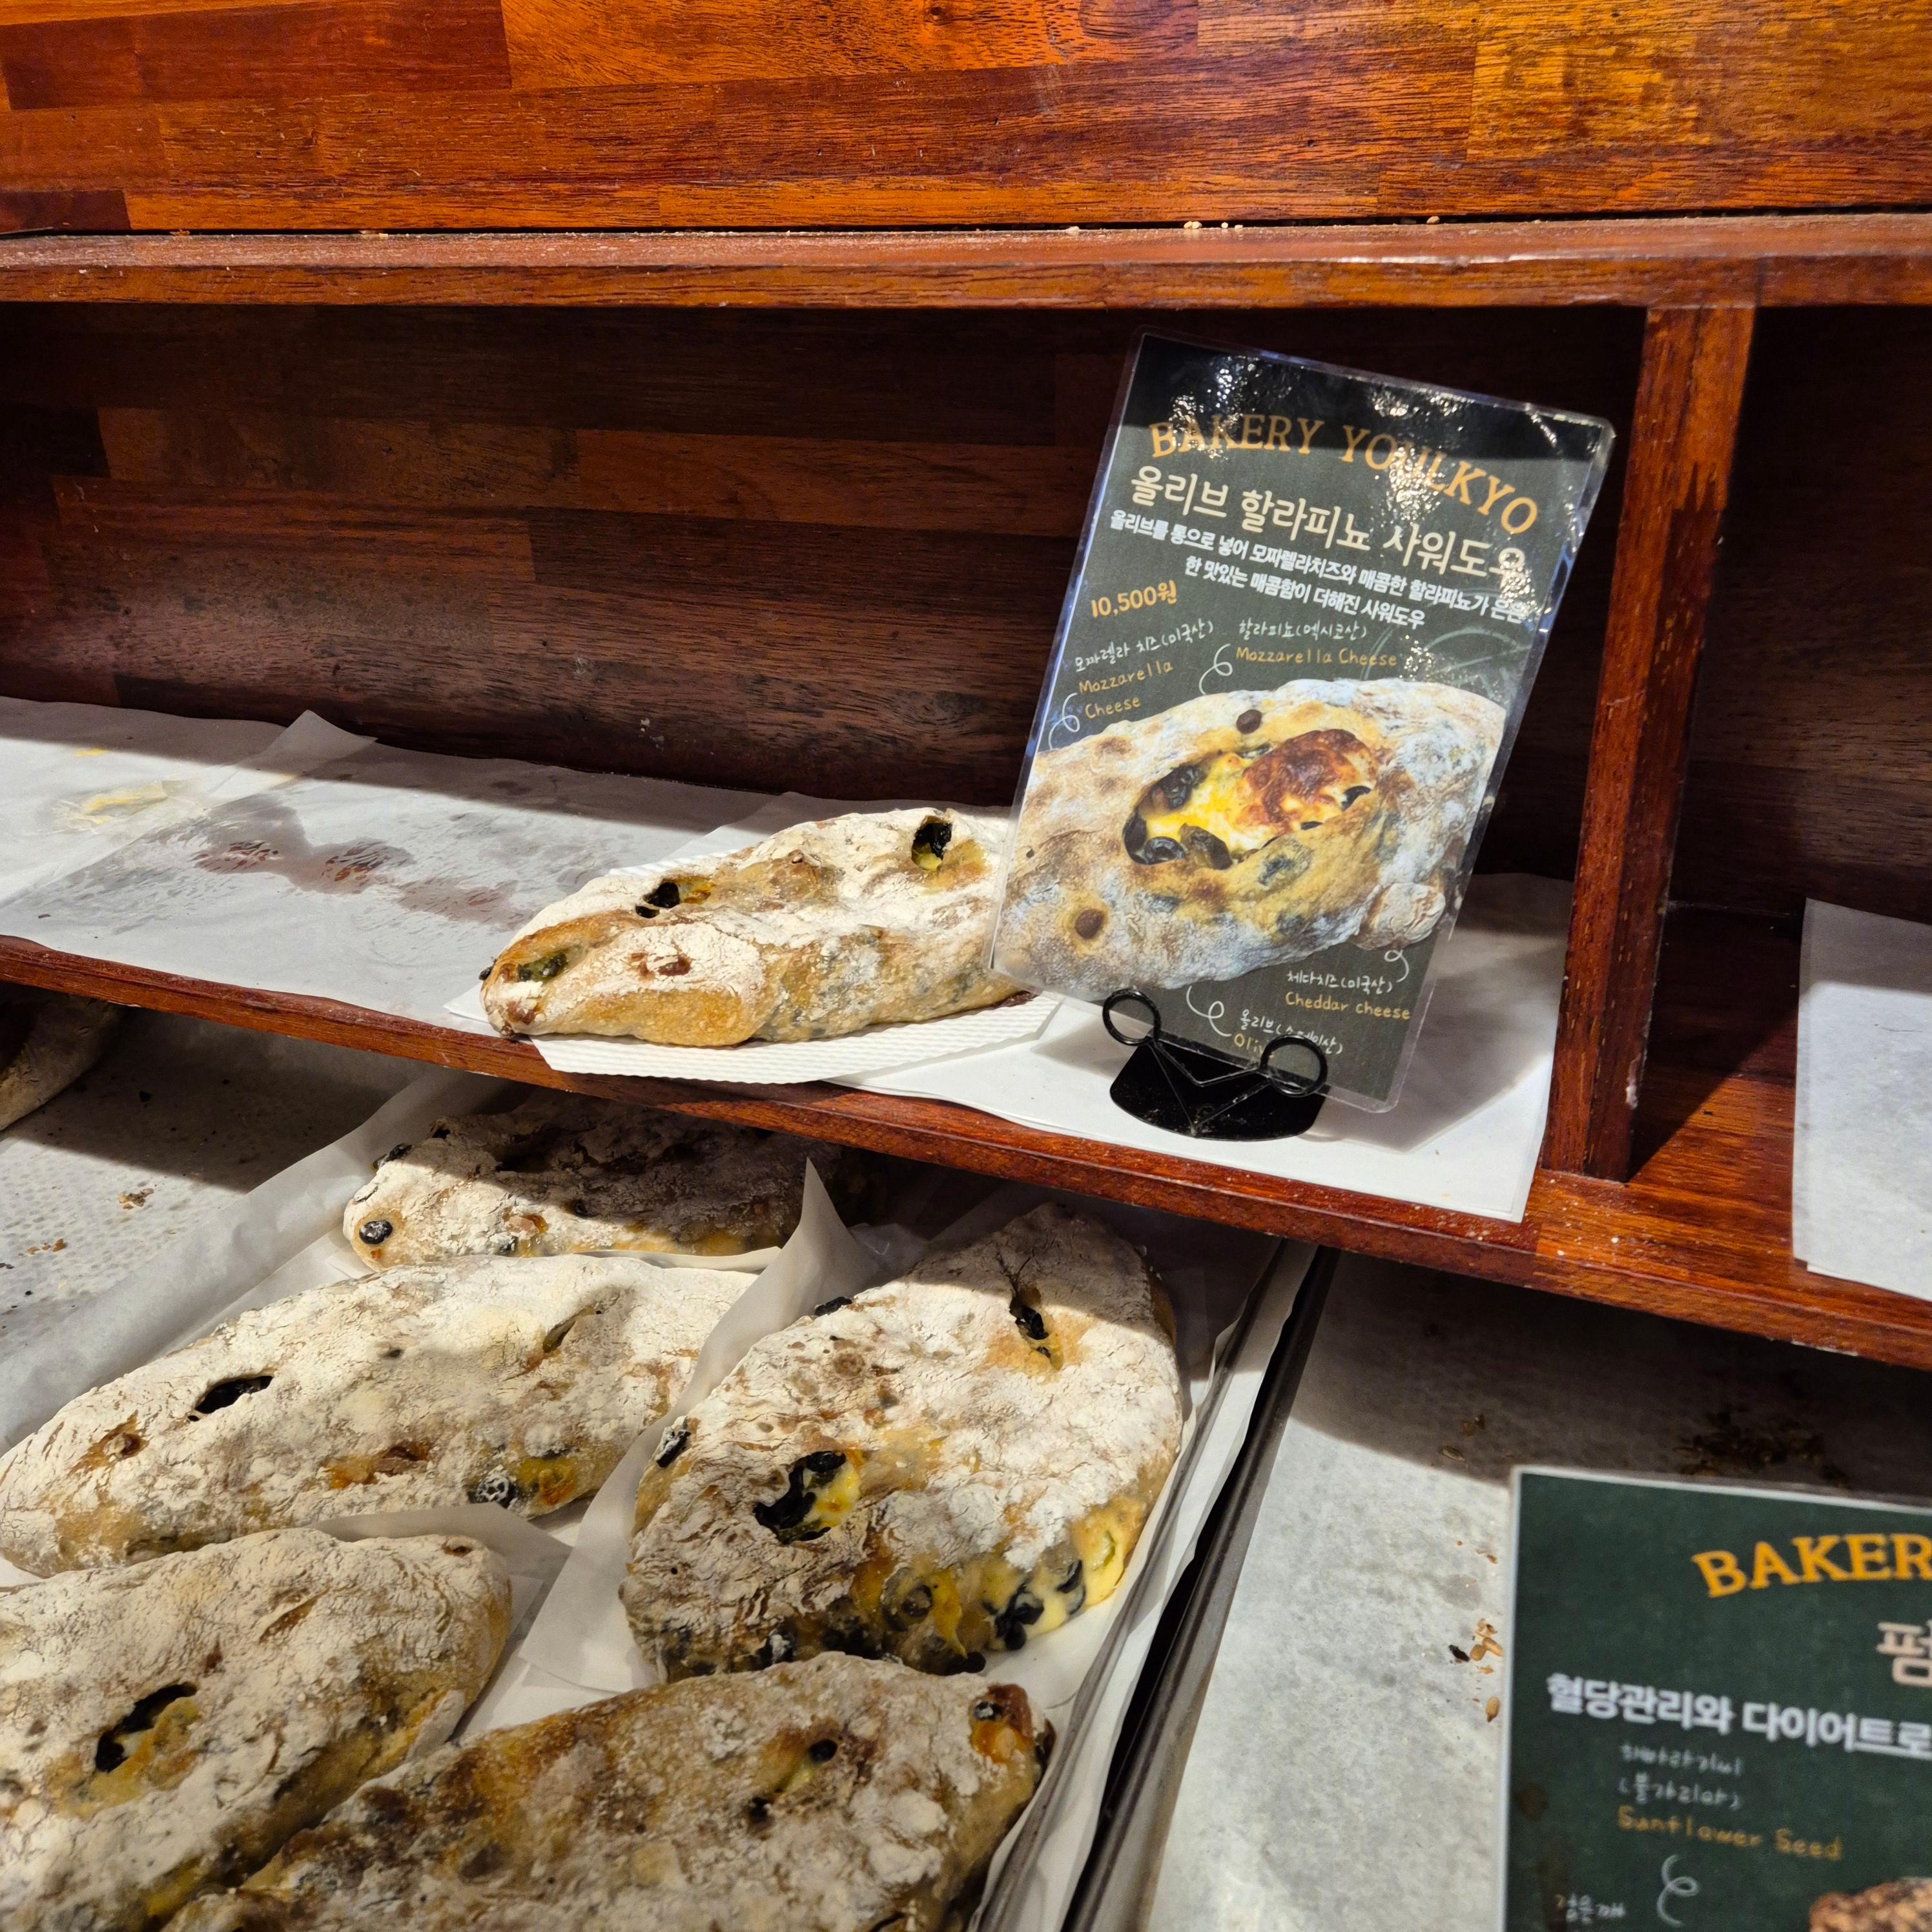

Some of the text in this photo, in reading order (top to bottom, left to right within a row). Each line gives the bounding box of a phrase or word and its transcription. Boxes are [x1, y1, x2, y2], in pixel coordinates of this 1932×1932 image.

[1149, 414, 1324, 458] BAKERY
[1131, 466, 1525, 590] 올리브 할라피뇨 사워도우
[1111, 509, 1169, 540] 올리브를
[1170, 524, 1216, 551] 통으로
[1218, 535, 1249, 560] 넣어
[1249, 543, 1357, 585] 모짜렐라치즈와
[1358, 569, 1407, 597] 매콤한
[1408, 579, 1489, 616] 할라피뇨가
[1091, 580, 1178, 619] 10,500원
[1185, 555, 1426, 630] 한 맛있는 매콤함이 더해진 사워도우
[1074, 641, 1130, 672] 모짜렐라
[1235, 647, 1397, 666] Mozzarella Cheese
[1078, 661, 1174, 694] Mozzarella
[1085, 697, 1141, 719] Cheese
[1285, 991, 1411, 1020] Cheddar cheese
[1233, 1033, 1275, 1058] Oliv
[1690, 1534, 1932, 1598] BAKER
[1547, 1672, 1932, 1762] 혈당관리와 다이어트로
[1618, 1805, 1842, 1862] Sunflower Seed
